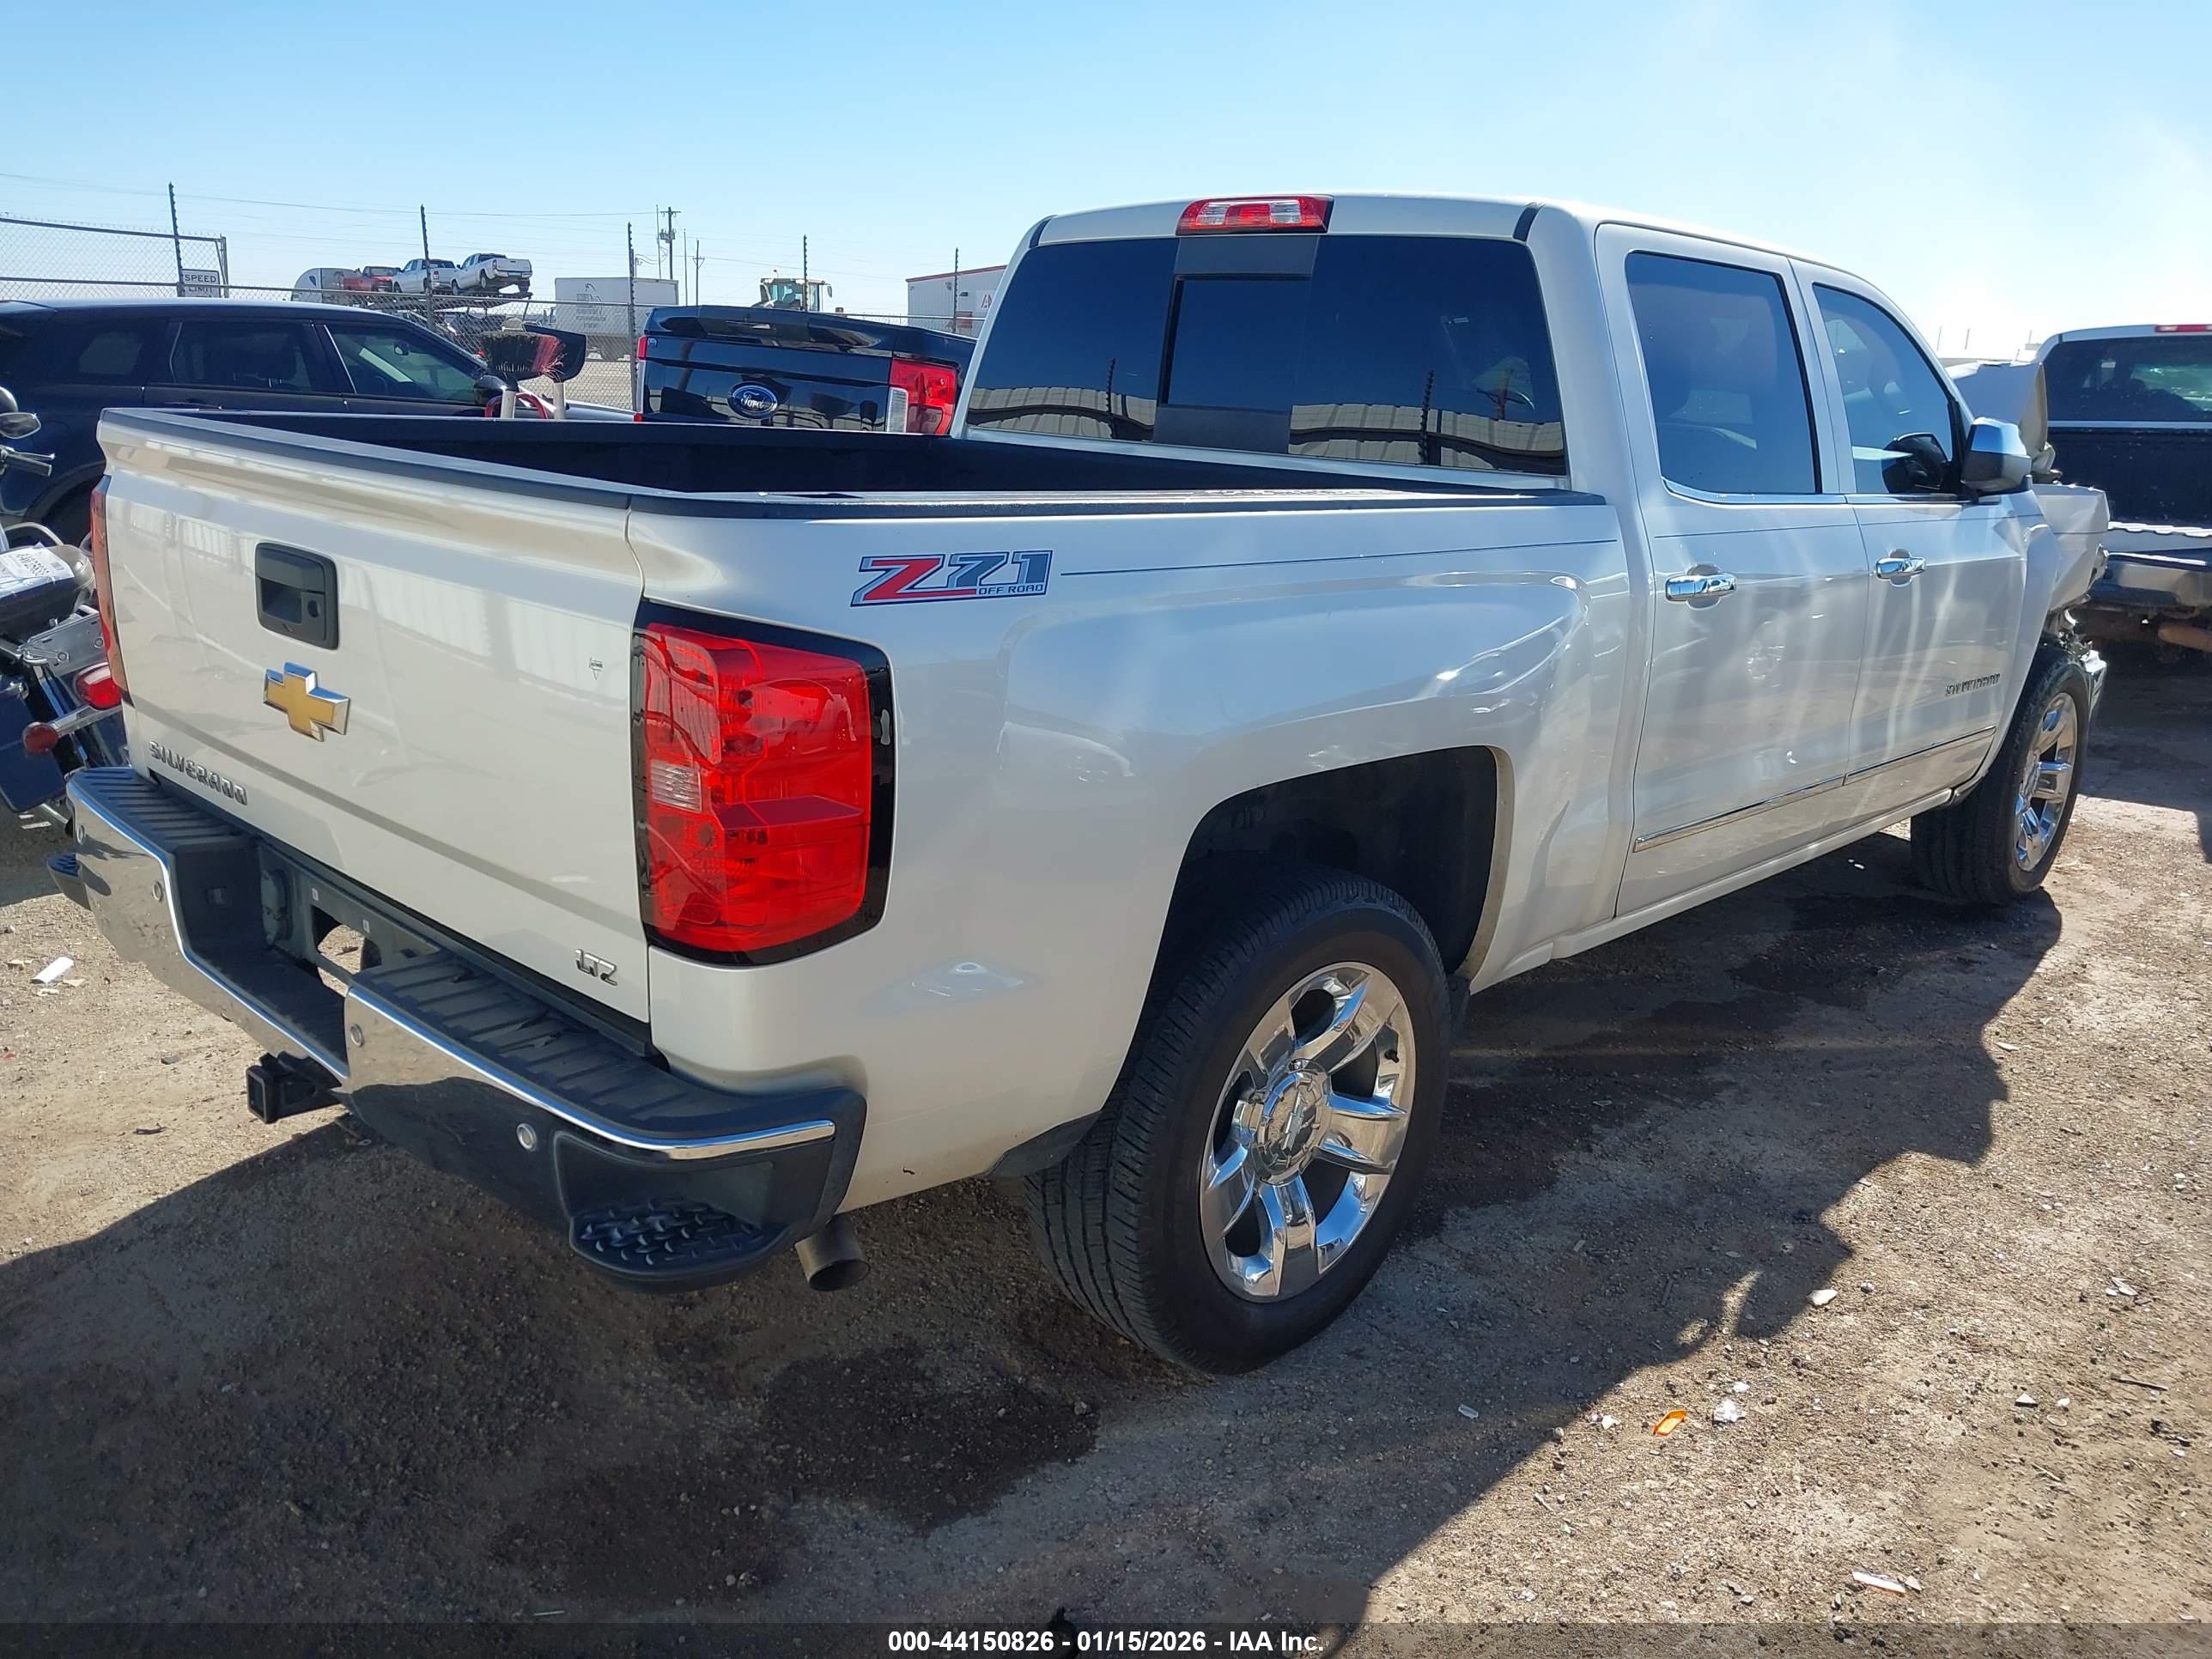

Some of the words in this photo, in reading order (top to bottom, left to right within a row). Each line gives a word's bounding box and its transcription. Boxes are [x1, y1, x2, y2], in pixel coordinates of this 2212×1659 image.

[185, 274, 216, 283] SPEED
[740, 391, 767, 409] Ford
[850, 550, 1053, 607] Z71
[978, 586, 1006, 596] OFF
[1007, 583, 1044, 594] ROAD
[149, 740, 247, 805] SILVERADO
[574, 949, 618, 987] LTZ
